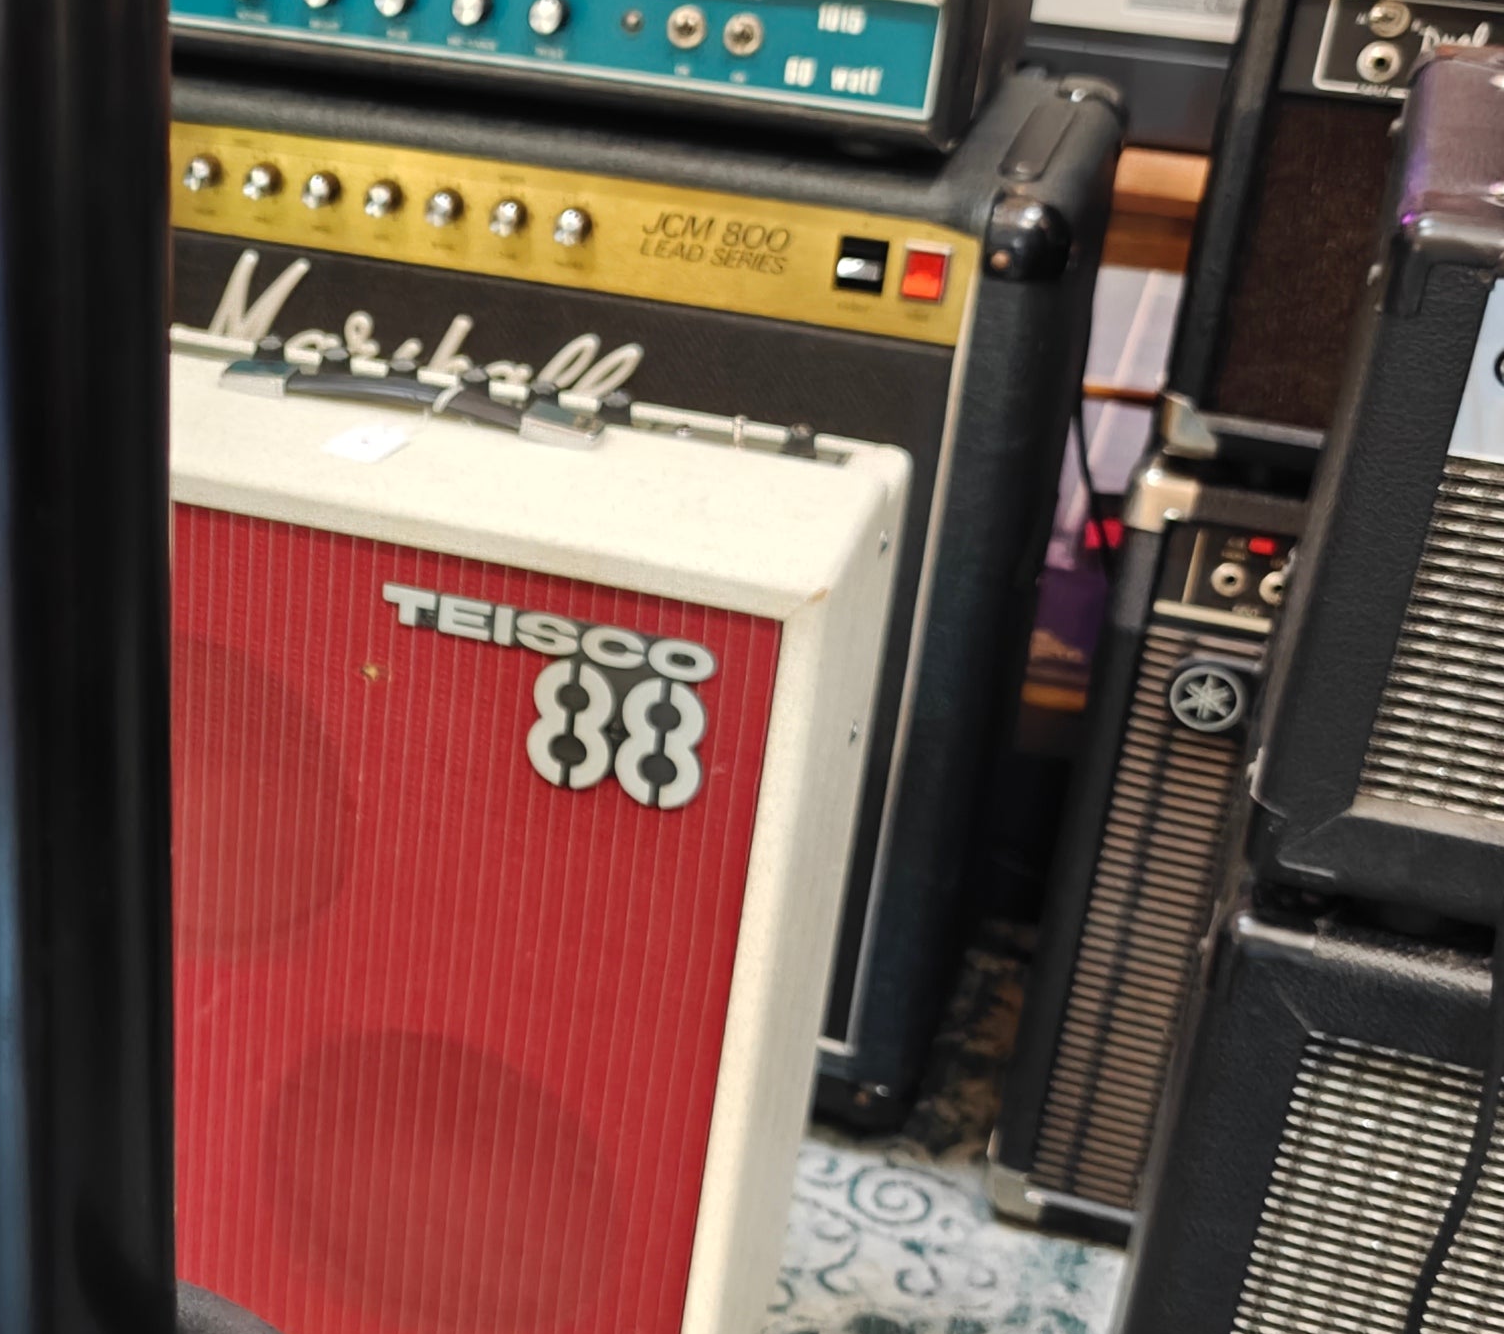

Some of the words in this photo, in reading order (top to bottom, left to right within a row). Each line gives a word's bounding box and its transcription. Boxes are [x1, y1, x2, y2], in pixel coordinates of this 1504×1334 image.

[639, 237, 704, 264] LEAD
[709, 247, 789, 276] SERIES
[641, 211, 715, 242] JCM
[722, 221, 791, 254] 800
[382, 581, 718, 683] TEISCO
[526, 657, 708, 810] 88
